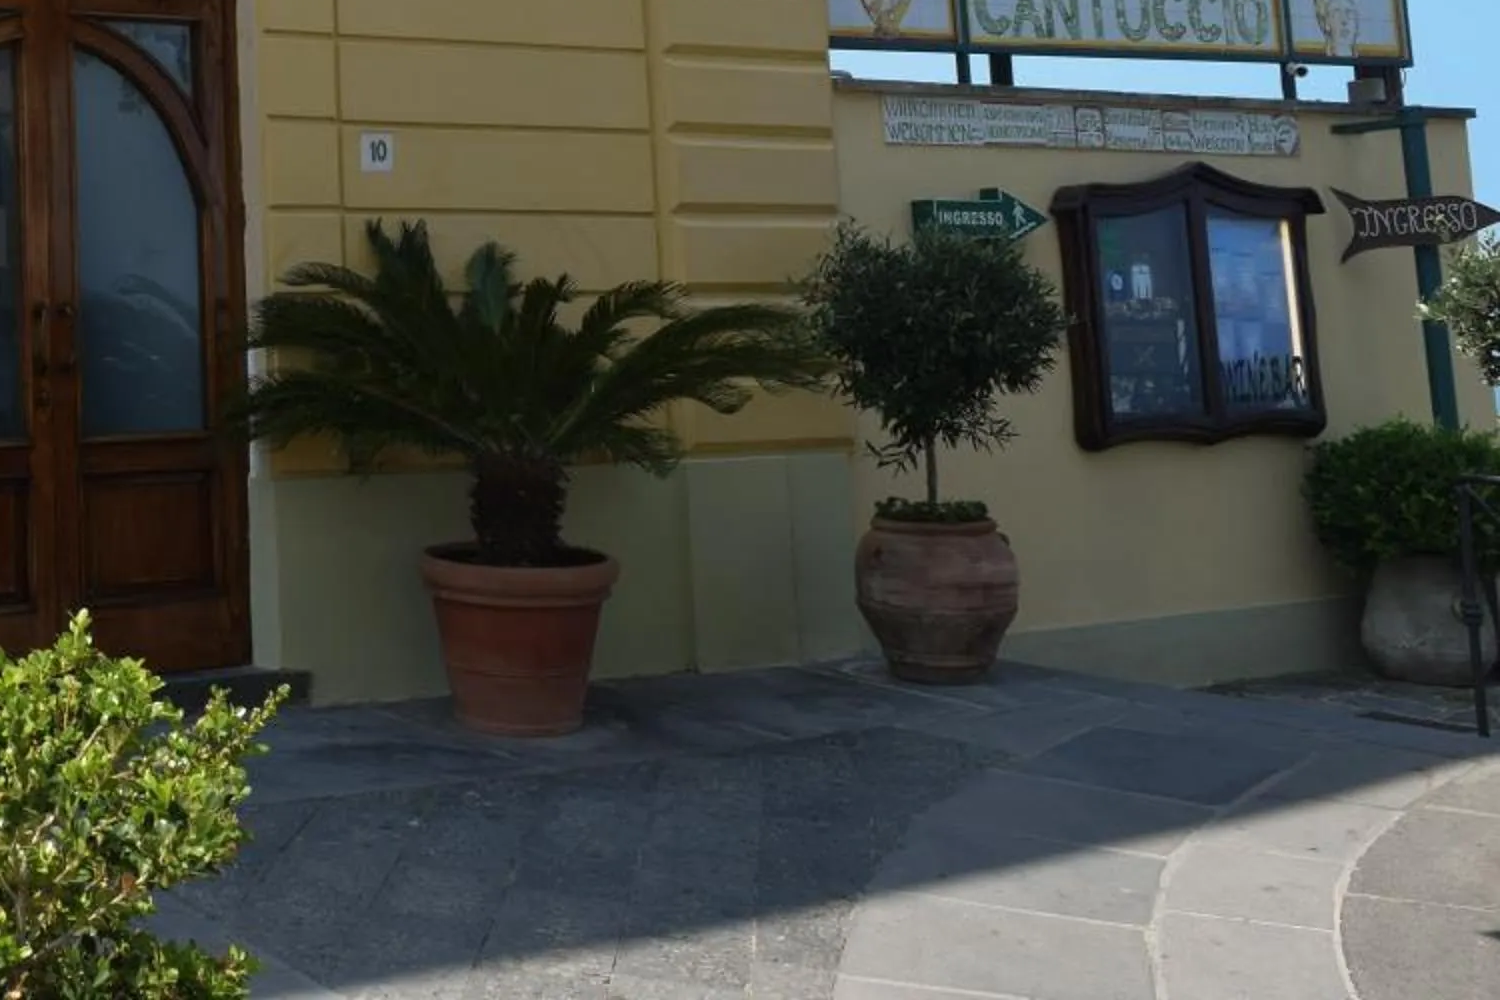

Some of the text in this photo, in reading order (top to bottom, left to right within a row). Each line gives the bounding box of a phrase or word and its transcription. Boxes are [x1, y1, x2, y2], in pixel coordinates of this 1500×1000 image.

[369, 139, 388, 163] 10
[938, 209, 1003, 226] INGRESSO
[1350, 201, 1477, 237] INGRESSO
